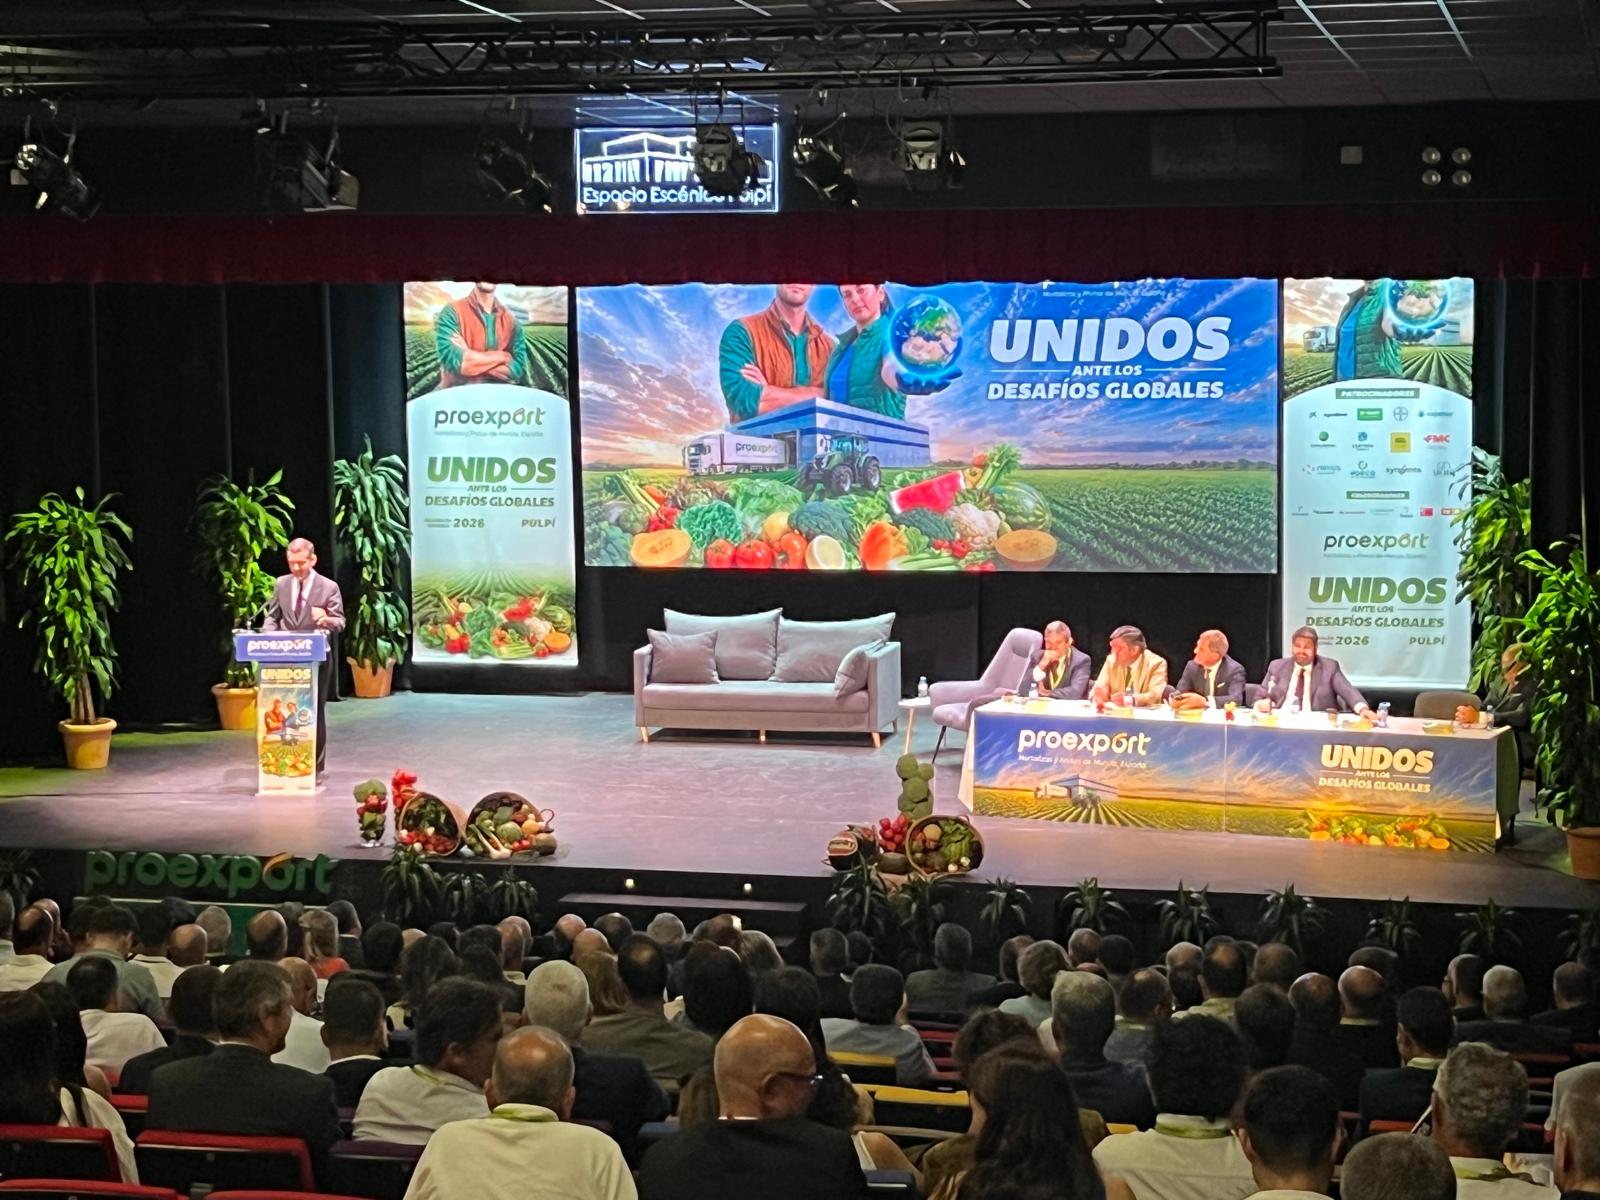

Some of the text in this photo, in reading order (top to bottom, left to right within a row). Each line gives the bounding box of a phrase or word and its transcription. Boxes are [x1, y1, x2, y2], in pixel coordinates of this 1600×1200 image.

[583, 187, 647, 206] Espacio
[990, 317, 1232, 363] UNIDOS
[1072, 365, 1142, 376] ANTE LOS
[987, 378, 1224, 399] DESAFÍOS GLOBALES
[434, 407, 546, 429] proexport
[427, 456, 556, 484] UNIDOS
[467, 485, 507, 493] ANTE LOS
[425, 493, 555, 507] DESAFÍOS GLOBALES
[453, 518, 485, 528] 2026
[521, 518, 556, 528] PULPÍ
[1323, 533, 1430, 551] proexport
[1308, 576, 1448, 605] UNIDOS
[1351, 605, 1394, 613] ANTE LOS
[1305, 615, 1445, 628] DESAFÍOS GLOBALES
[247, 639, 313, 652] proexport
[1335, 636, 1369, 645] 2026
[1409, 635, 1445, 645] PULPÍ
[260, 668, 311, 680] UNIDOS
[1017, 729, 1152, 757] proexport
[1320, 744, 1435, 774] UNIDOS
[1354, 770, 1391, 779] ANTE LOS
[1318, 777, 1431, 793] DESAFÍOS GLOBALES
[84, 850, 340, 898] proexport
